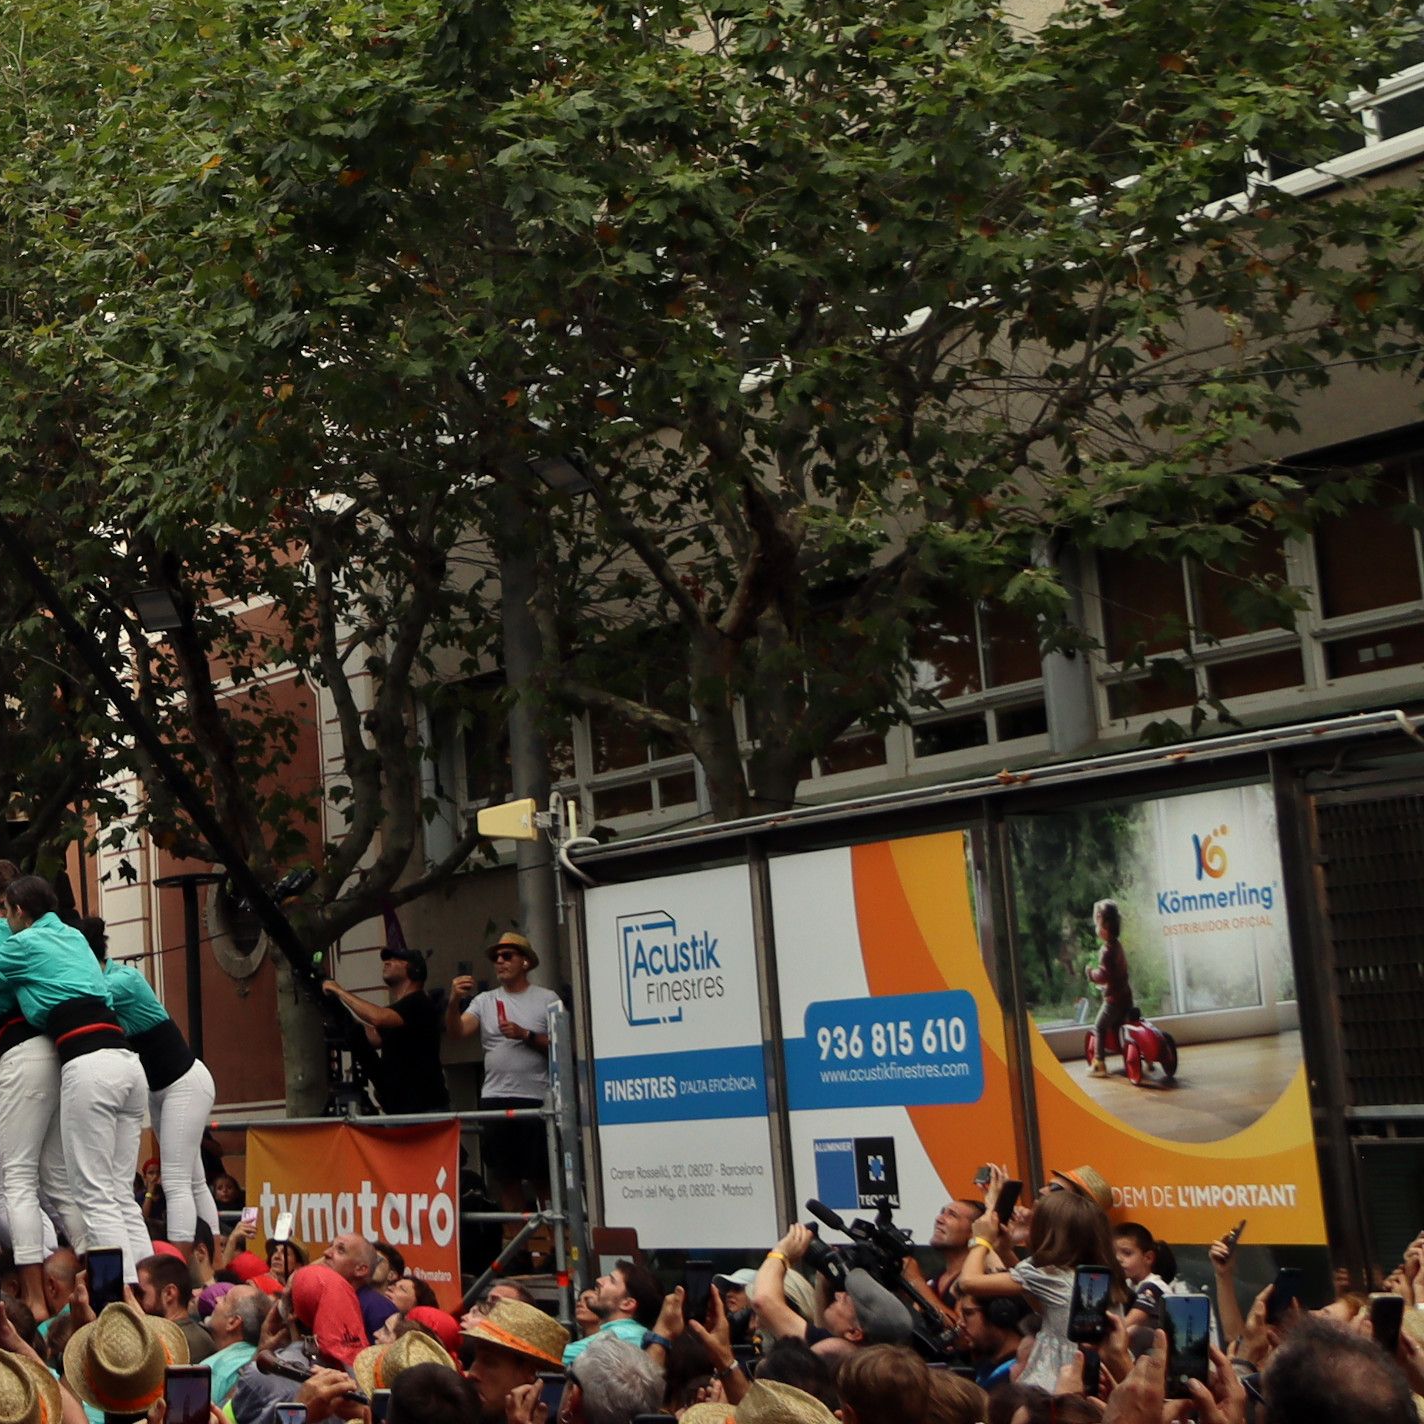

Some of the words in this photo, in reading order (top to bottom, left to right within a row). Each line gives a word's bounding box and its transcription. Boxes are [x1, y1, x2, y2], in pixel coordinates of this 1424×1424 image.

[1163, 919, 1231, 936] DISTRIBUIDOR
[1233, 915, 1273, 930] OFICIAL
[632, 930, 721, 978] Acustik
[647, 975, 725, 1004] Finestres
[817, 1025, 864, 1061] 936
[871, 1020, 914, 1058] 815
[921, 1016, 967, 1054] 610
[819, 1062, 970, 1083] www.acustikfinestres.com
[604, 1076, 677, 1102] FINESTRES
[720, 1160, 765, 1177] Barcelona
[1151, 1186, 1175, 1208] DE
[1176, 1183, 1297, 1208] L'IMPORTANT
